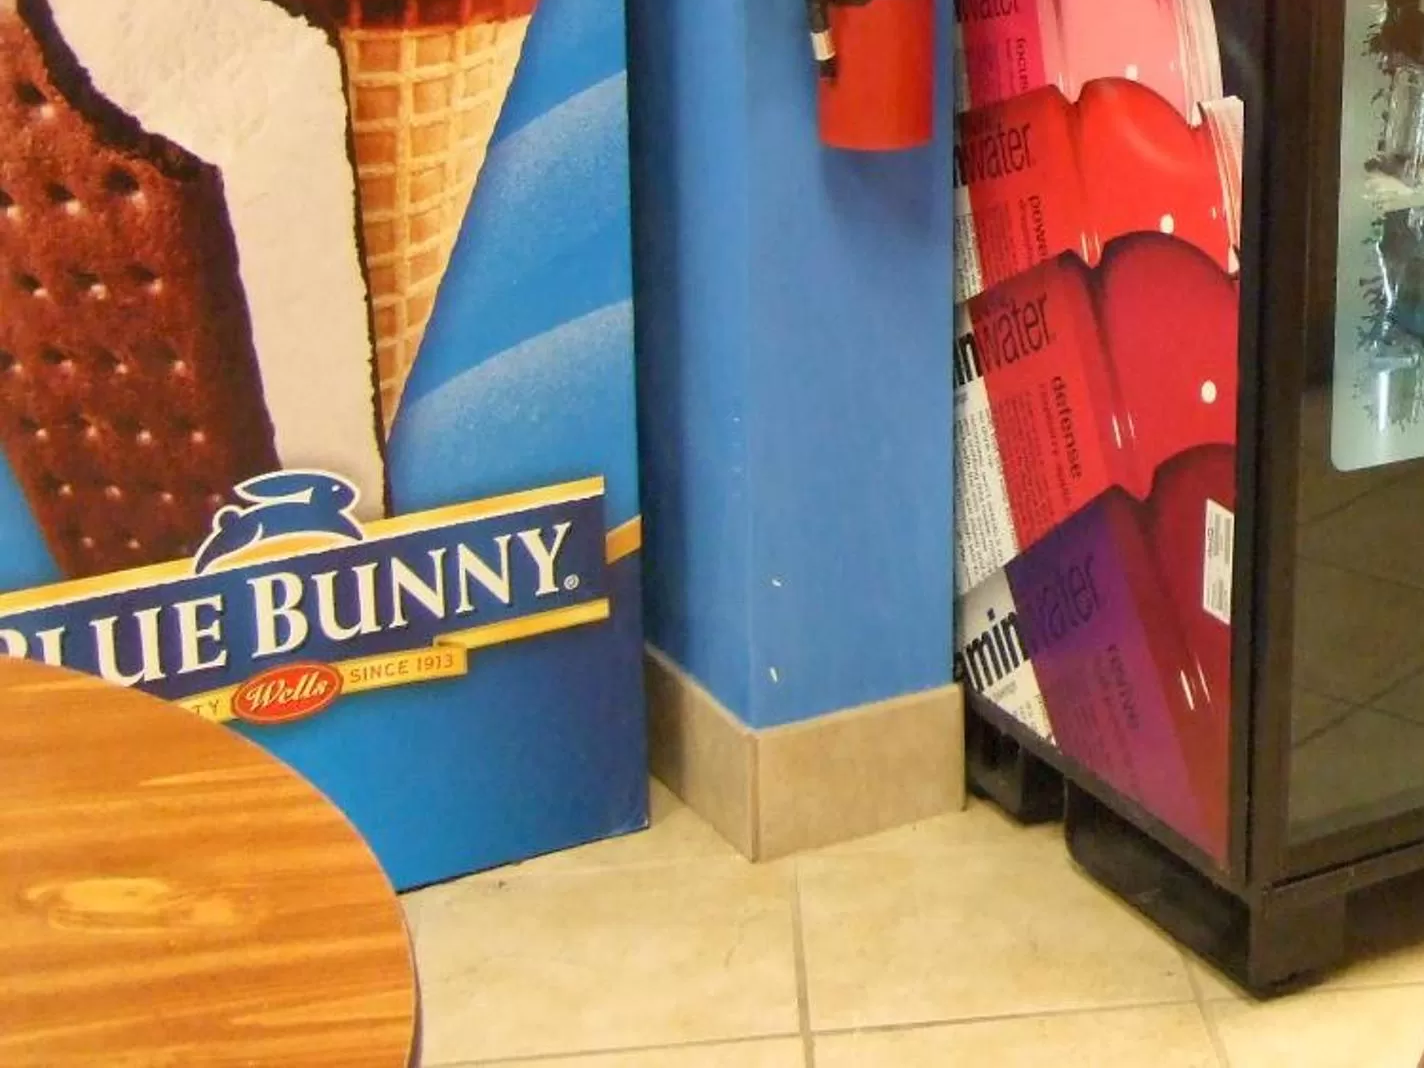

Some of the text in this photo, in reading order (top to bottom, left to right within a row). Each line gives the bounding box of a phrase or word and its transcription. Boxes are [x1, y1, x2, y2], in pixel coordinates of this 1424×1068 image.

[1051, 375, 1084, 482] defense
[246, 523, 574, 660] BUNNY
[245, 670, 329, 712] Wells
[350, 652, 455, 684] SINCE 1913
